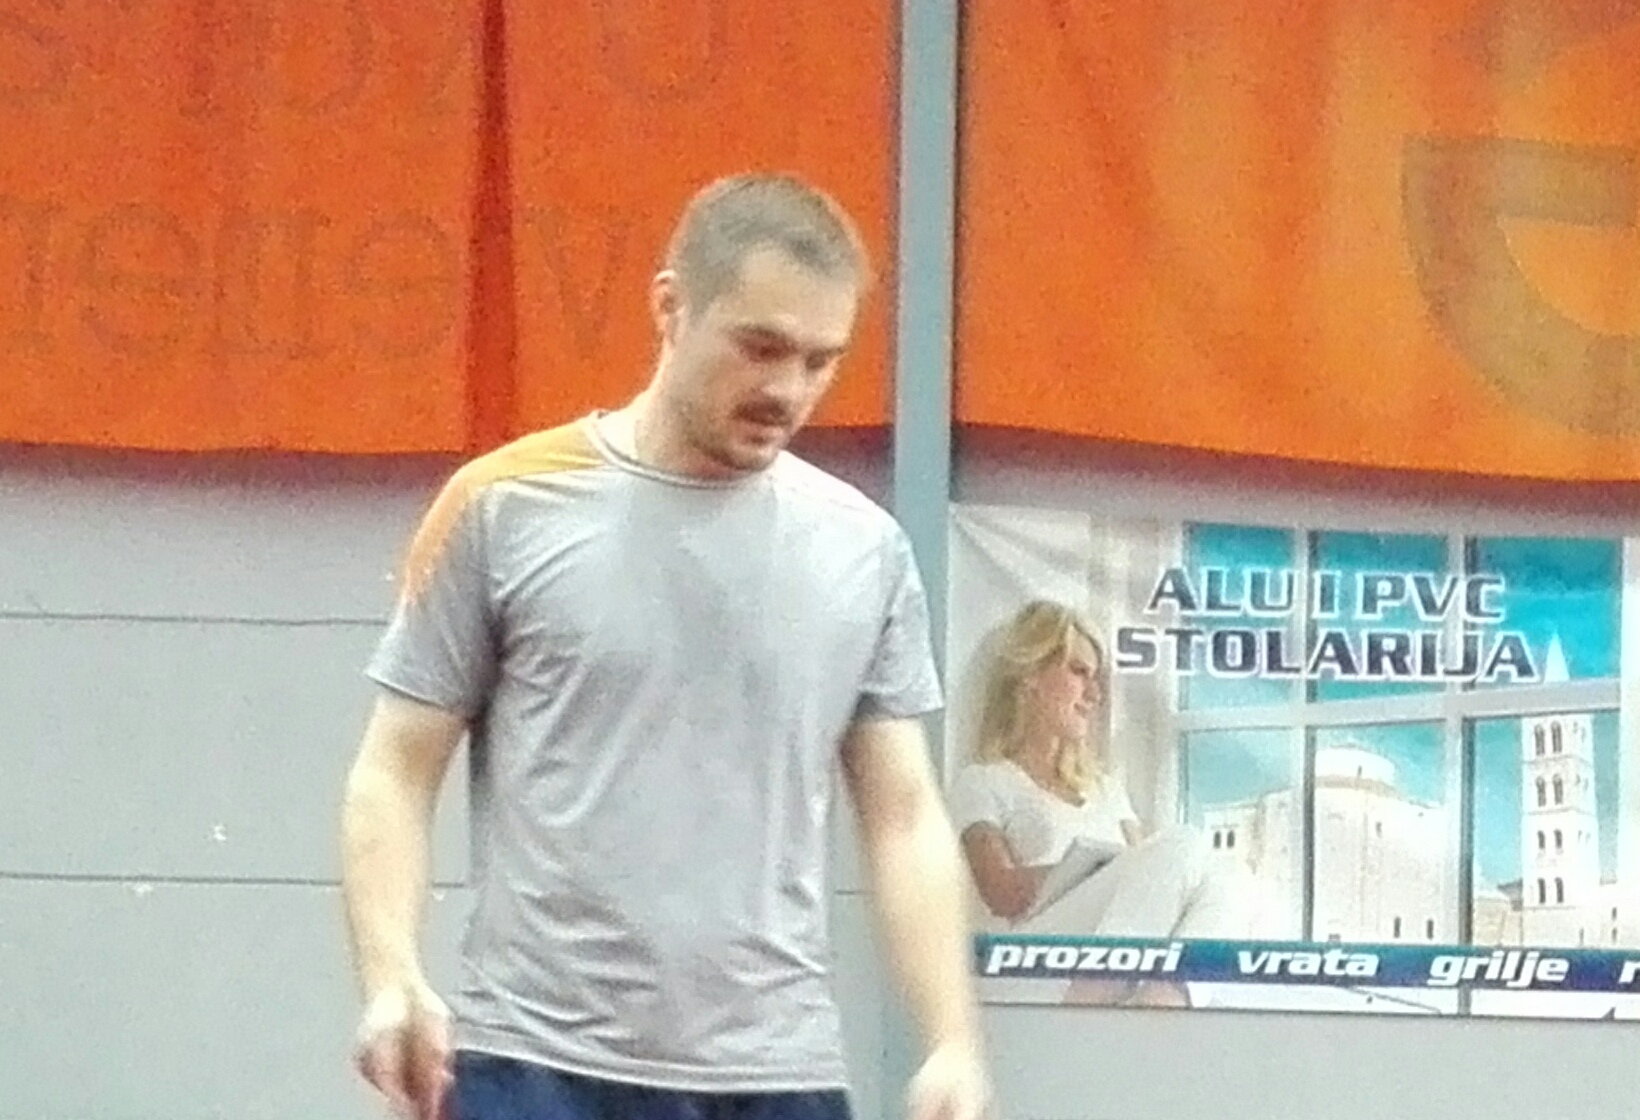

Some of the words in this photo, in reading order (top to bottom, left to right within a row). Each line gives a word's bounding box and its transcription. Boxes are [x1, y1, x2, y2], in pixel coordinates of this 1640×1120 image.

[1145, 566, 1298, 616] ALU
[1312, 570, 1341, 618] I
[1355, 571, 1506, 622] PVC
[1116, 625, 1541, 682] STOLARIJA
[986, 942, 1184, 974] prozori
[1237, 948, 1380, 976] vrata
[1426, 951, 1569, 987] grilje
